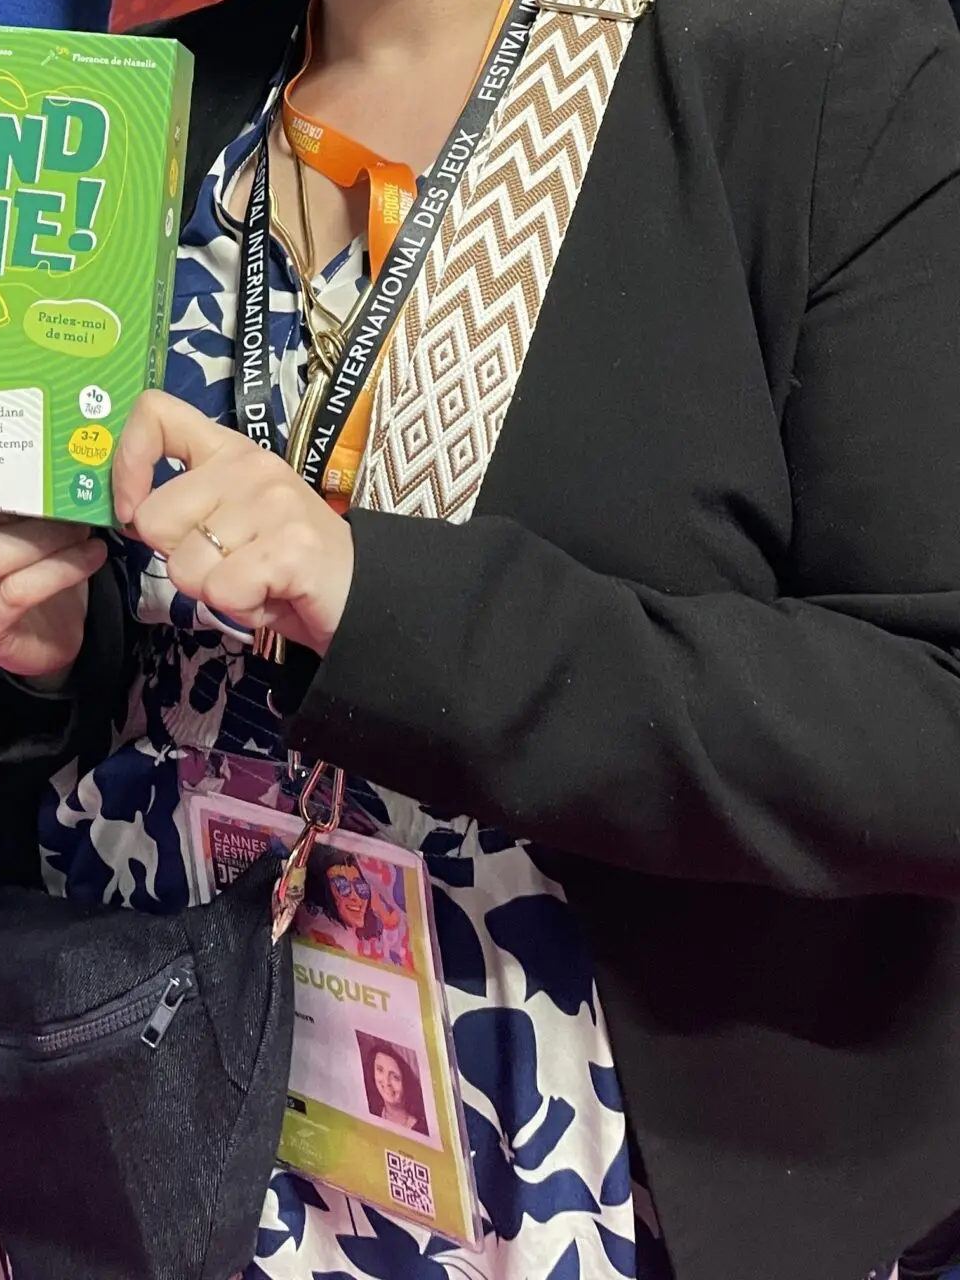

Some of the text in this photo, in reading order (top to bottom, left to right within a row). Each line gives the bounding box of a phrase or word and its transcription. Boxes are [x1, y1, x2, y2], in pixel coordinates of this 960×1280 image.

[478, 20, 533, 102] FESTIVAL
[249, 146, 267, 228] FESTIVAL
[327, 235, 426, 415] INTERNATIONAL
[413, 185, 450, 230] DES
[439, 129, 480, 184] JEUX
[38, 311, 106, 330] Parlez-moi
[243, 229, 265, 395] INTERNATIONAL
[45, 327, 61, 340] de
[63, 332, 88, 344] moi
[81, 430, 100, 442] 3-7
[79, 474, 94, 489] 20
[213, 829, 268, 853] CANNES
